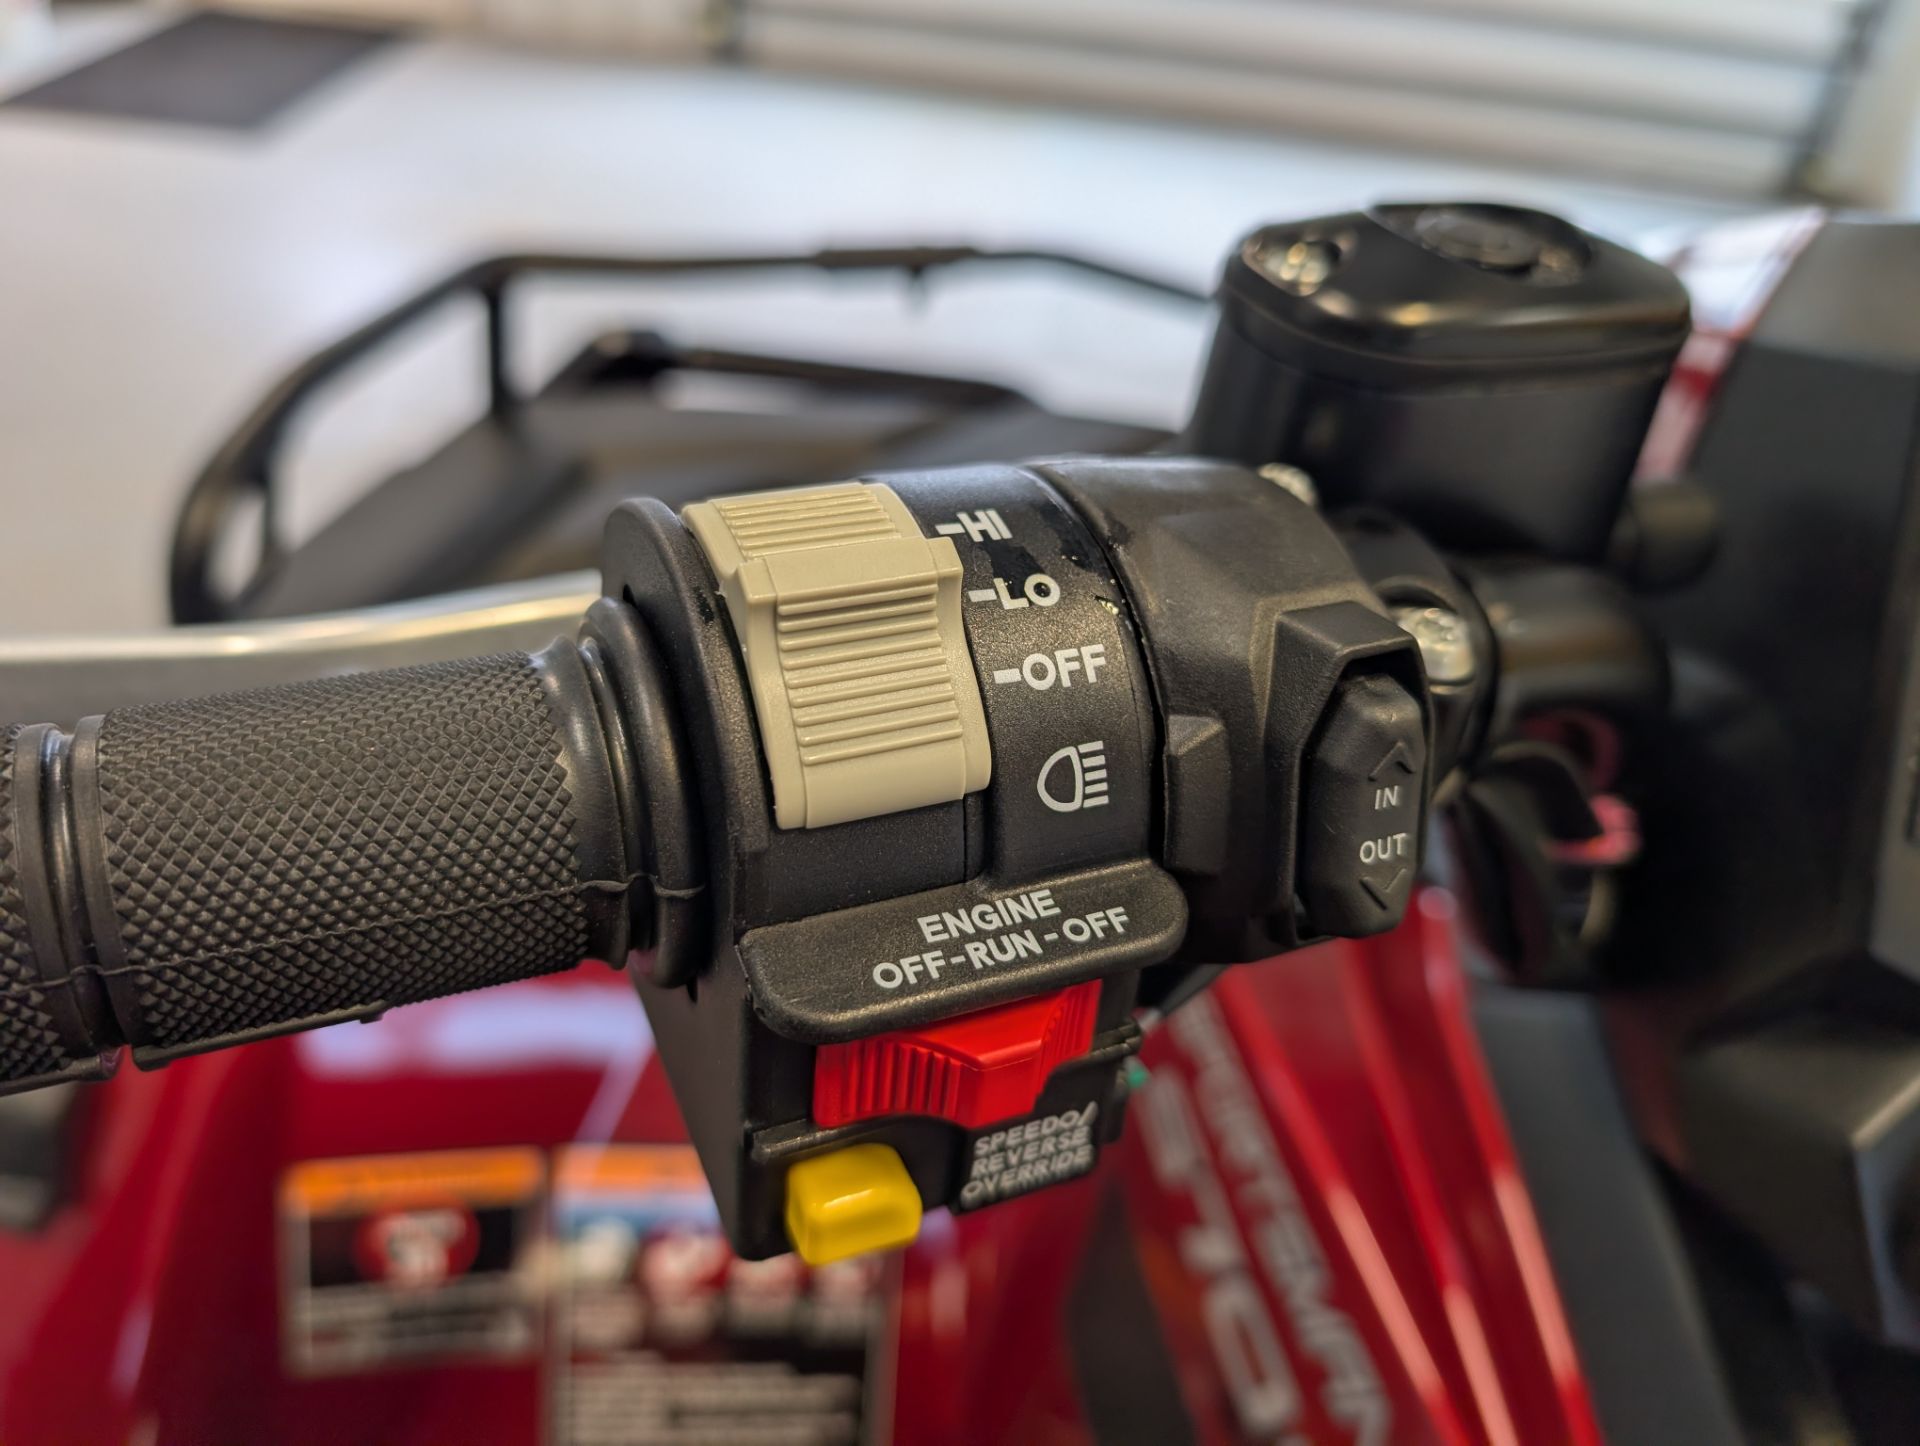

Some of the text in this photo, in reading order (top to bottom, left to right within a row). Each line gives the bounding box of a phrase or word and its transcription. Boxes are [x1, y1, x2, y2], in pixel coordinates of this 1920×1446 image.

[1374, 785, 1399, 810] IN
[1359, 833, 1407, 864] OUT
[917, 889, 1061, 943] ENGINE
[970, 1126, 1092, 1181] REVERSE
[974, 1101, 1099, 1157] SPEEDO/
[960, 1144, 1093, 1204] OVERRIDE
